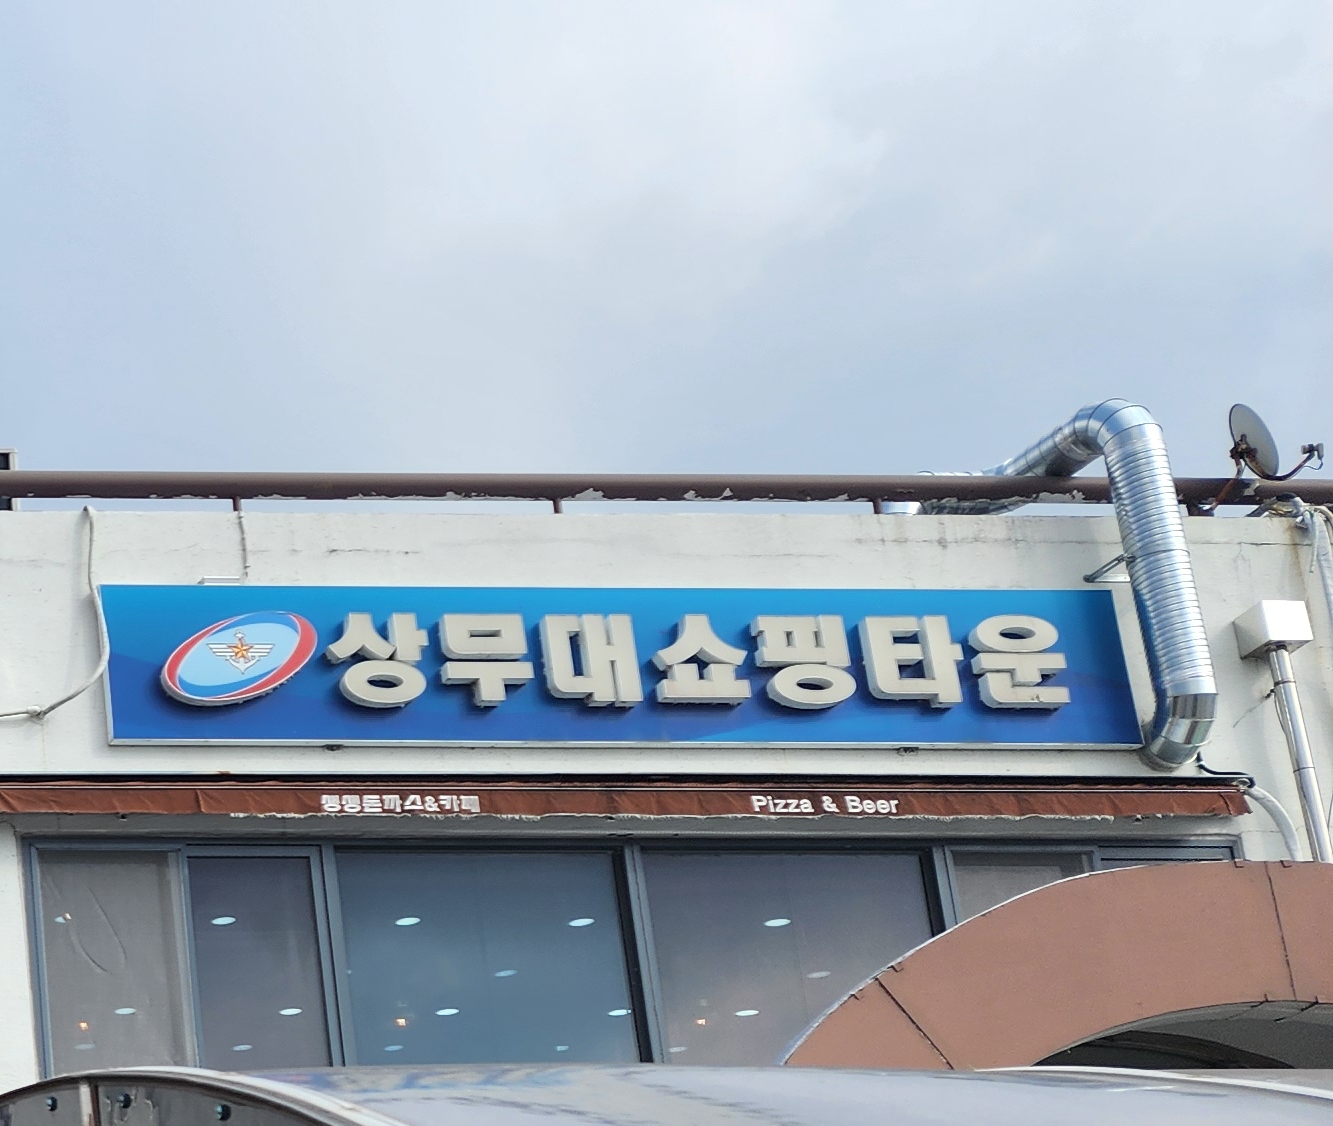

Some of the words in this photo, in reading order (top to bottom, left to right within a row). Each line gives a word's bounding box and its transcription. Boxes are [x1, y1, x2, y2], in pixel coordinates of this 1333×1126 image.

[324, 611, 1072, 710] 상무대쇼핑타운
[751, 795, 815, 813] Pizza
[821, 795, 840, 813] &
[844, 795, 899, 814] Beer
